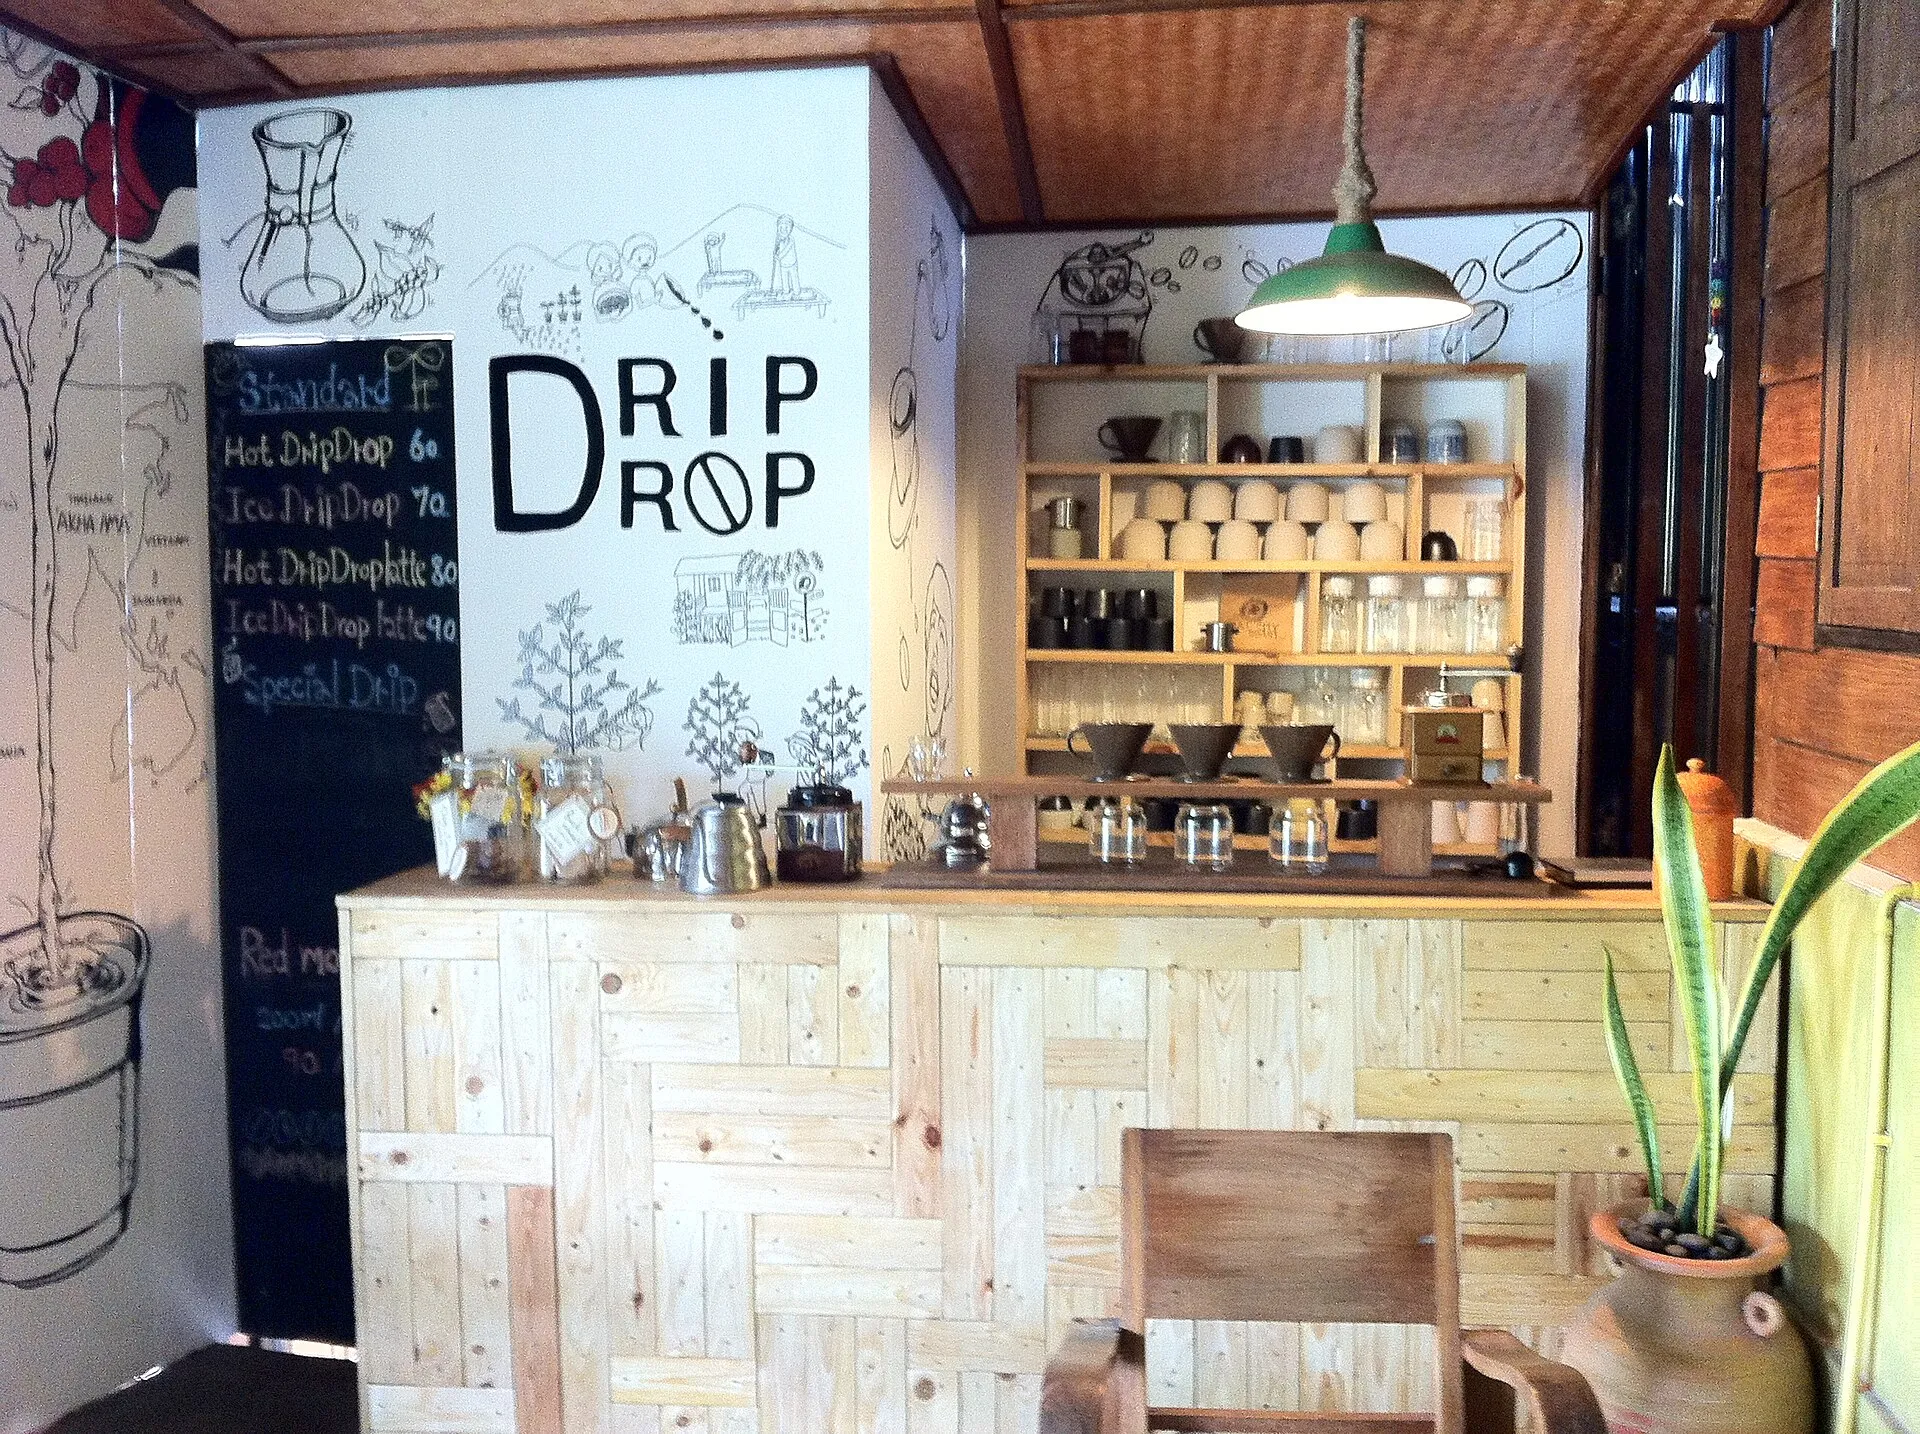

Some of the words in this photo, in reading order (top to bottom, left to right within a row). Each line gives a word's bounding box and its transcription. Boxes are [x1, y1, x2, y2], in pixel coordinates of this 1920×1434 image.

[239, 362, 391, 412] Standard
[224, 433, 273, 468] Hot
[409, 427, 438, 463] 60
[225, 485, 274, 524] Ice
[410, 484, 449, 519] 70
[223, 548, 272, 586] Hot
[430, 553, 458, 588] 80
[426, 613, 457, 643] 90
[242, 657, 340, 716] Special
[350, 662, 418, 714] Drip
[240, 926, 290, 977] Red
